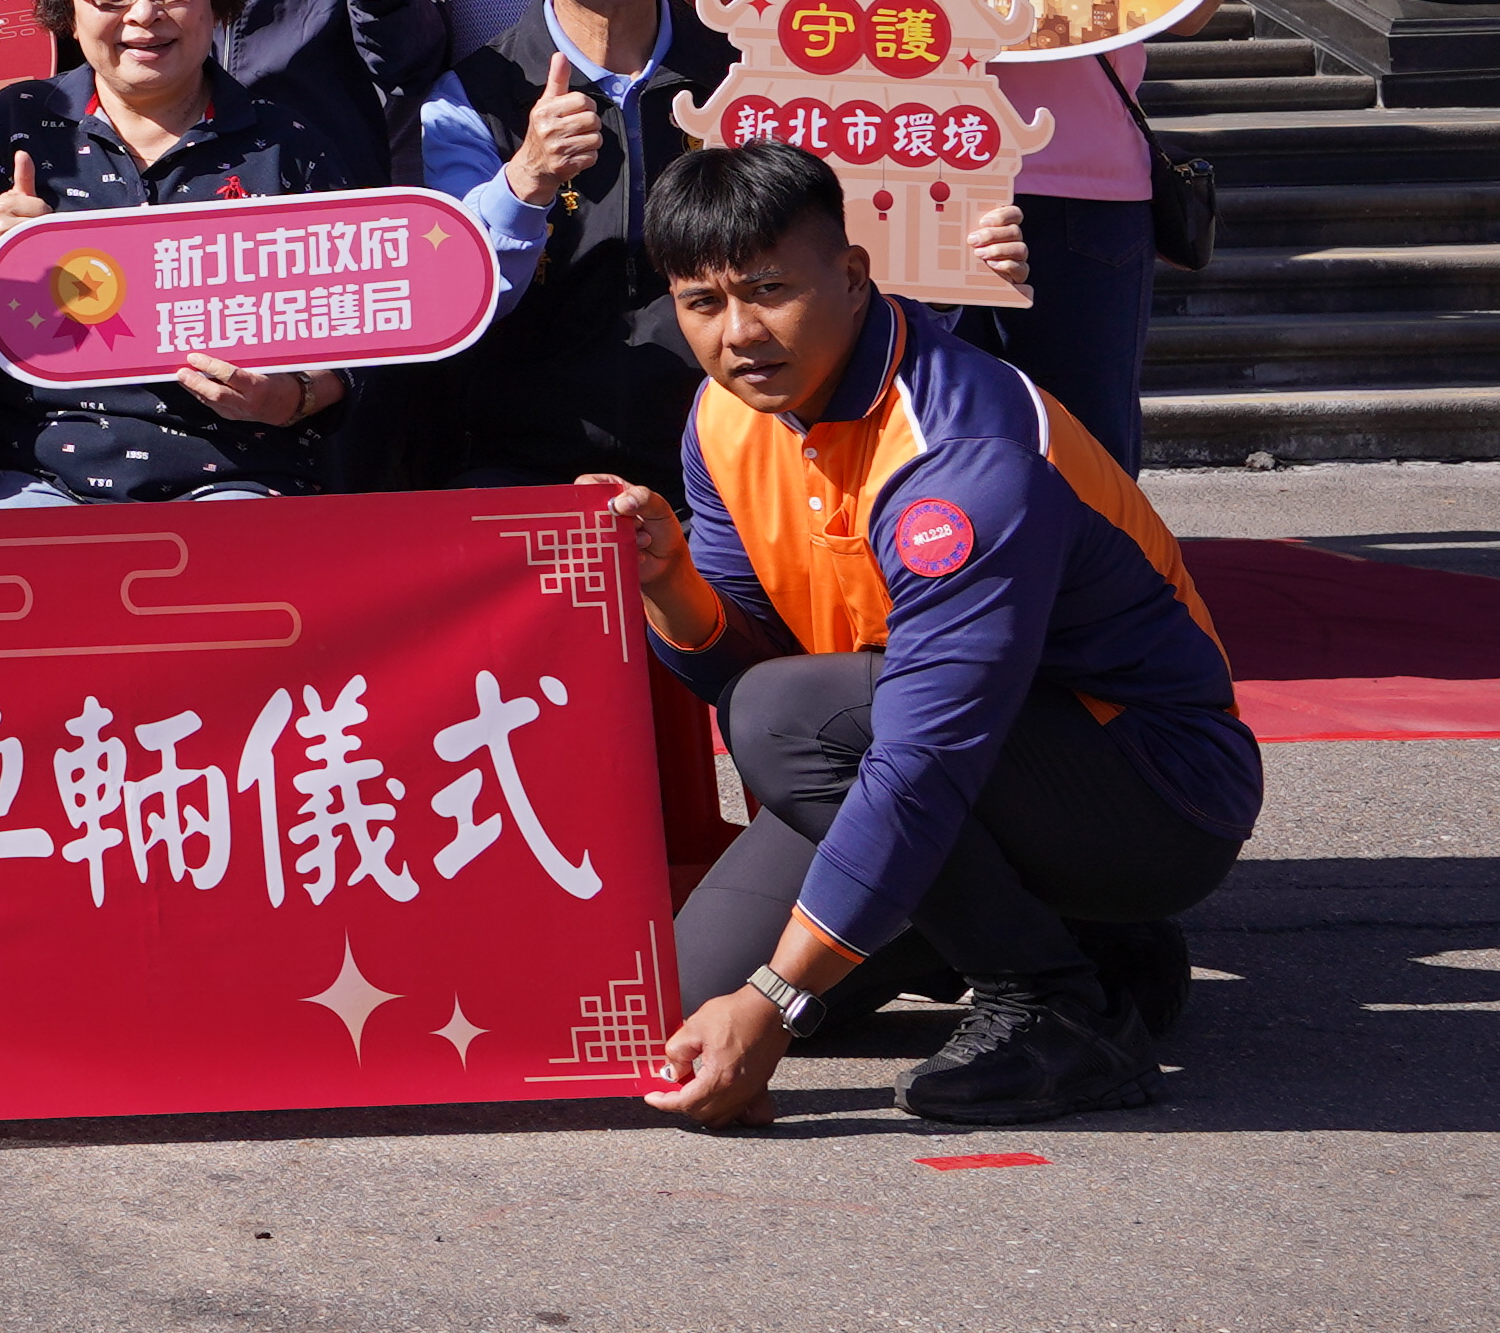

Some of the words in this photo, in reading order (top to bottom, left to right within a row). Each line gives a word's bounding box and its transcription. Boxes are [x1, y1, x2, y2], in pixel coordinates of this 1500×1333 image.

[792, 3, 941, 62] 守護
[734, 105, 990, 162] 新北市環境
[153, 218, 409, 290] 新北市政府
[156, 281, 411, 354] 環境保護局
